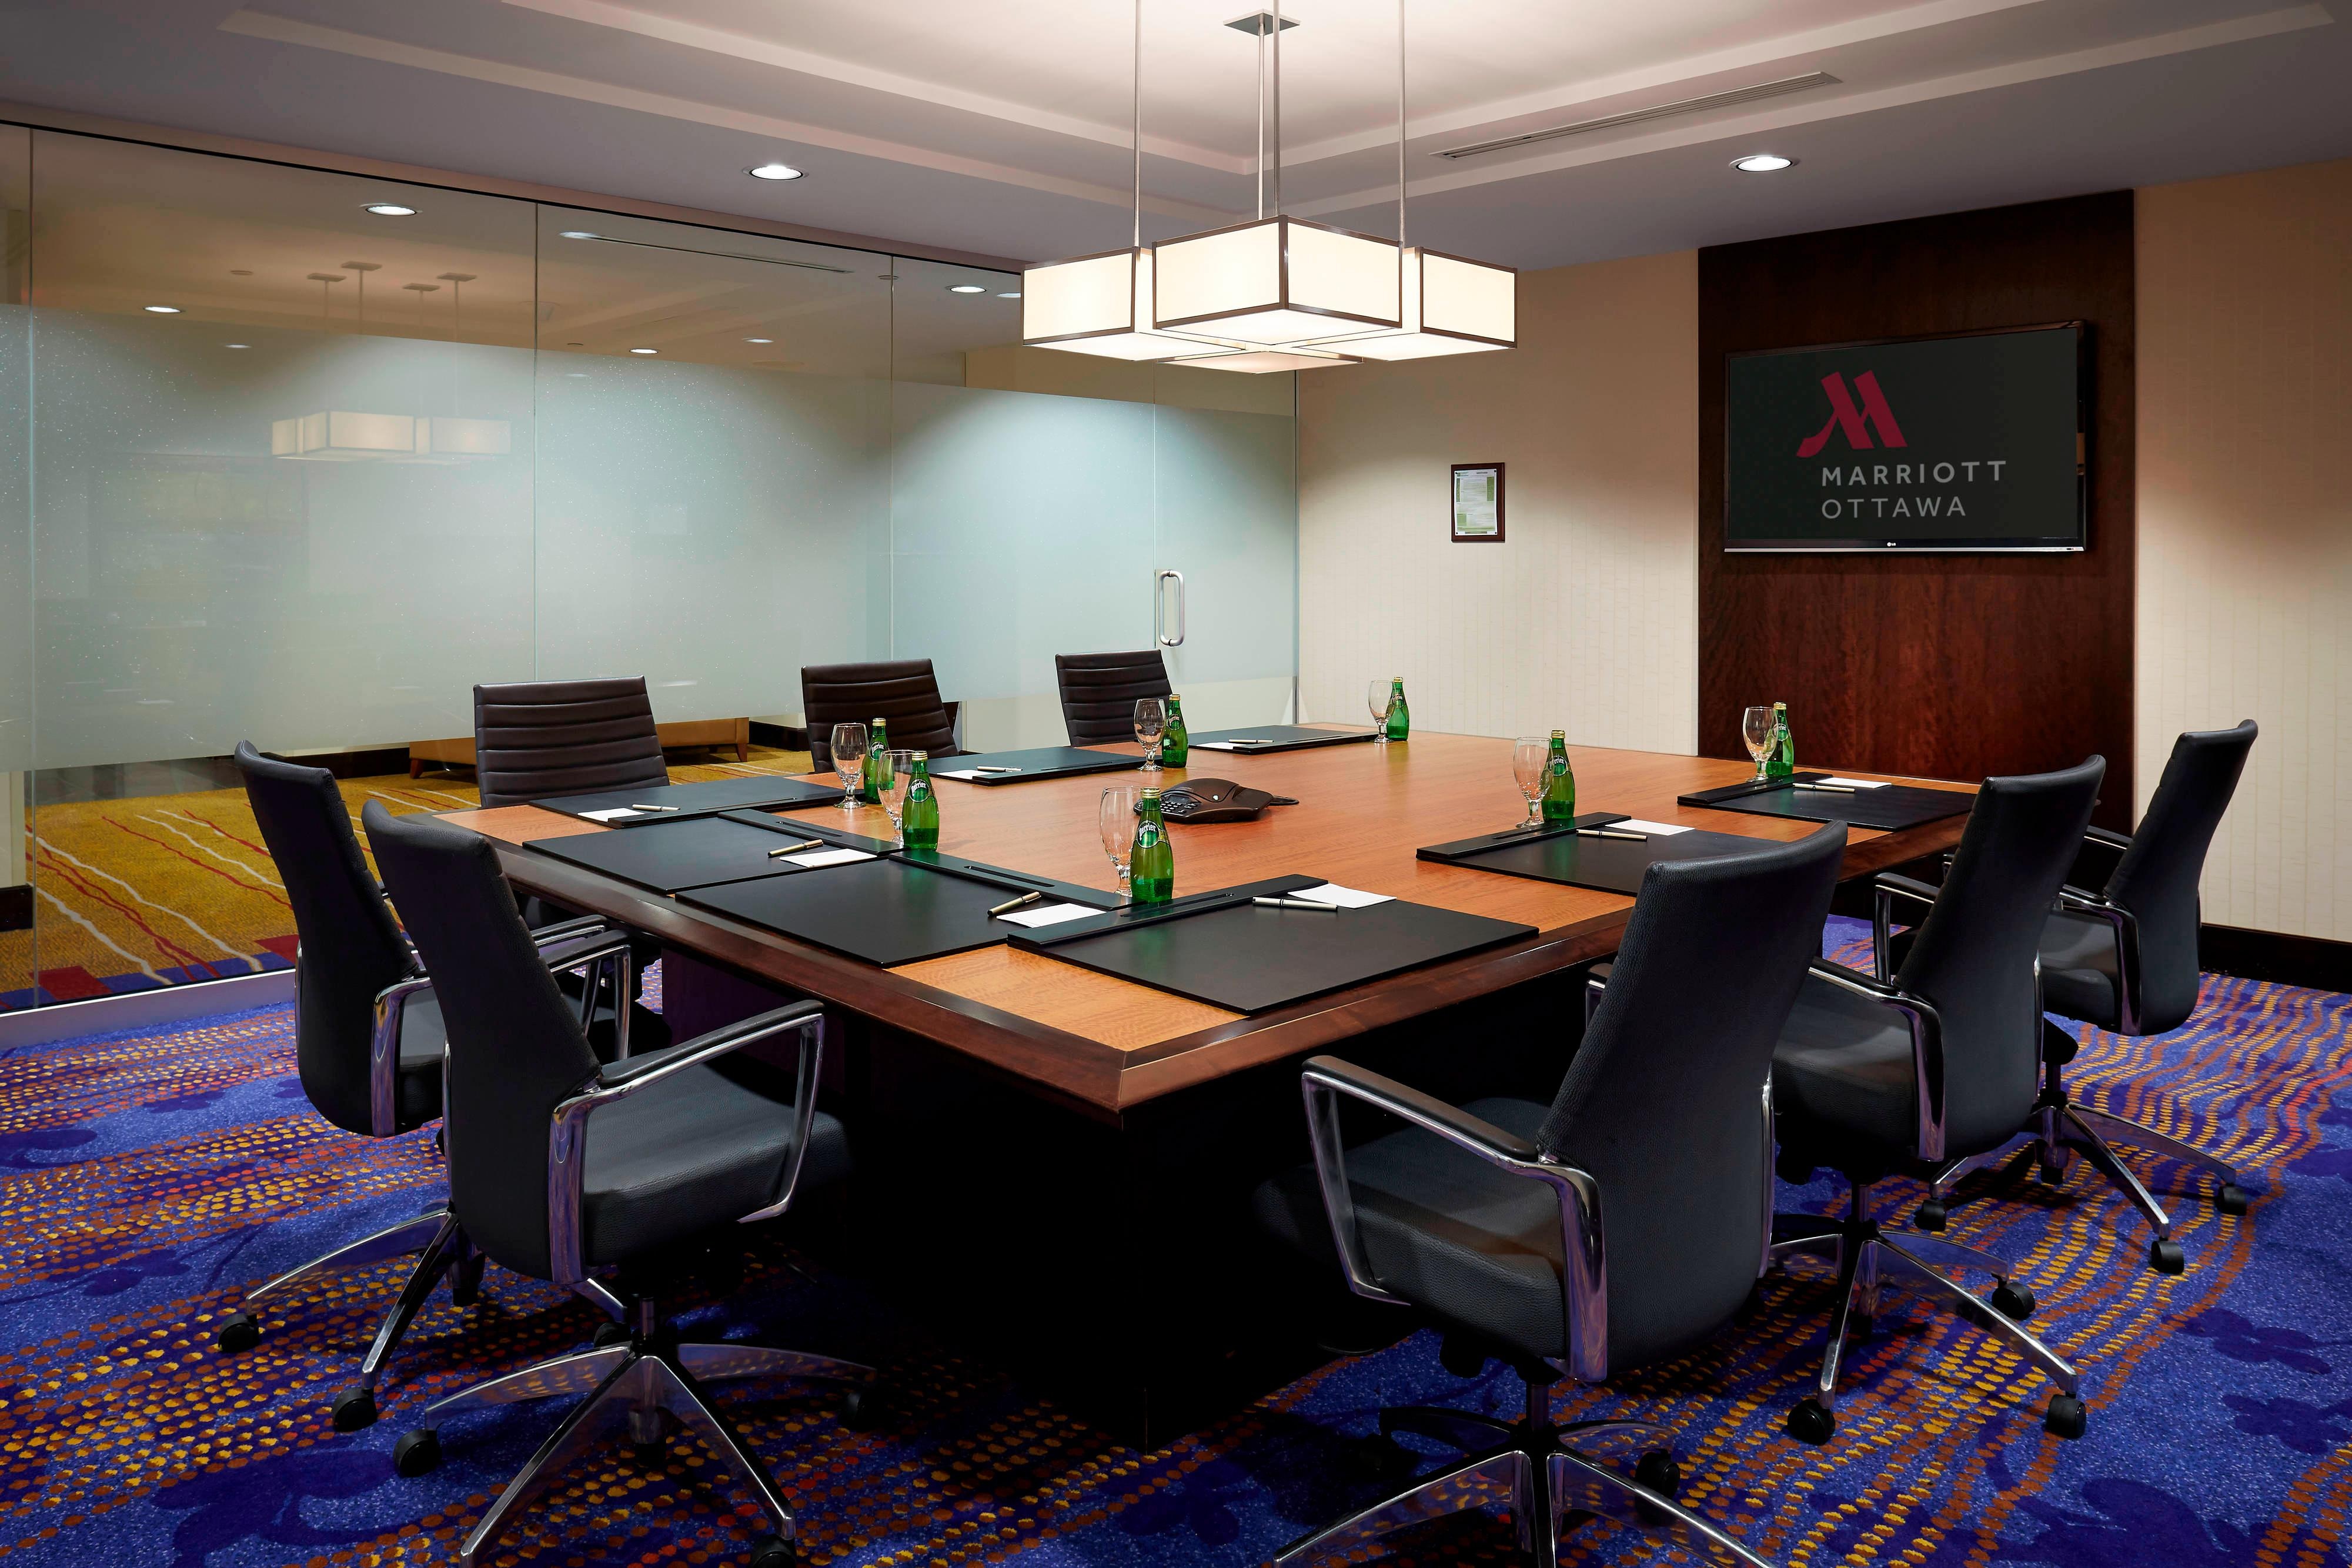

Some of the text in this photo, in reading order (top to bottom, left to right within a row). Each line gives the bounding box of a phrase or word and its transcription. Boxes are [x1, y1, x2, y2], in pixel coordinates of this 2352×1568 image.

[1822, 460, 2007, 487] MARRIOTT
[1821, 496, 1966, 519] OTTAWA
[911, 781, 927, 797] Perrier
[1138, 823, 1157, 841] Perrier
